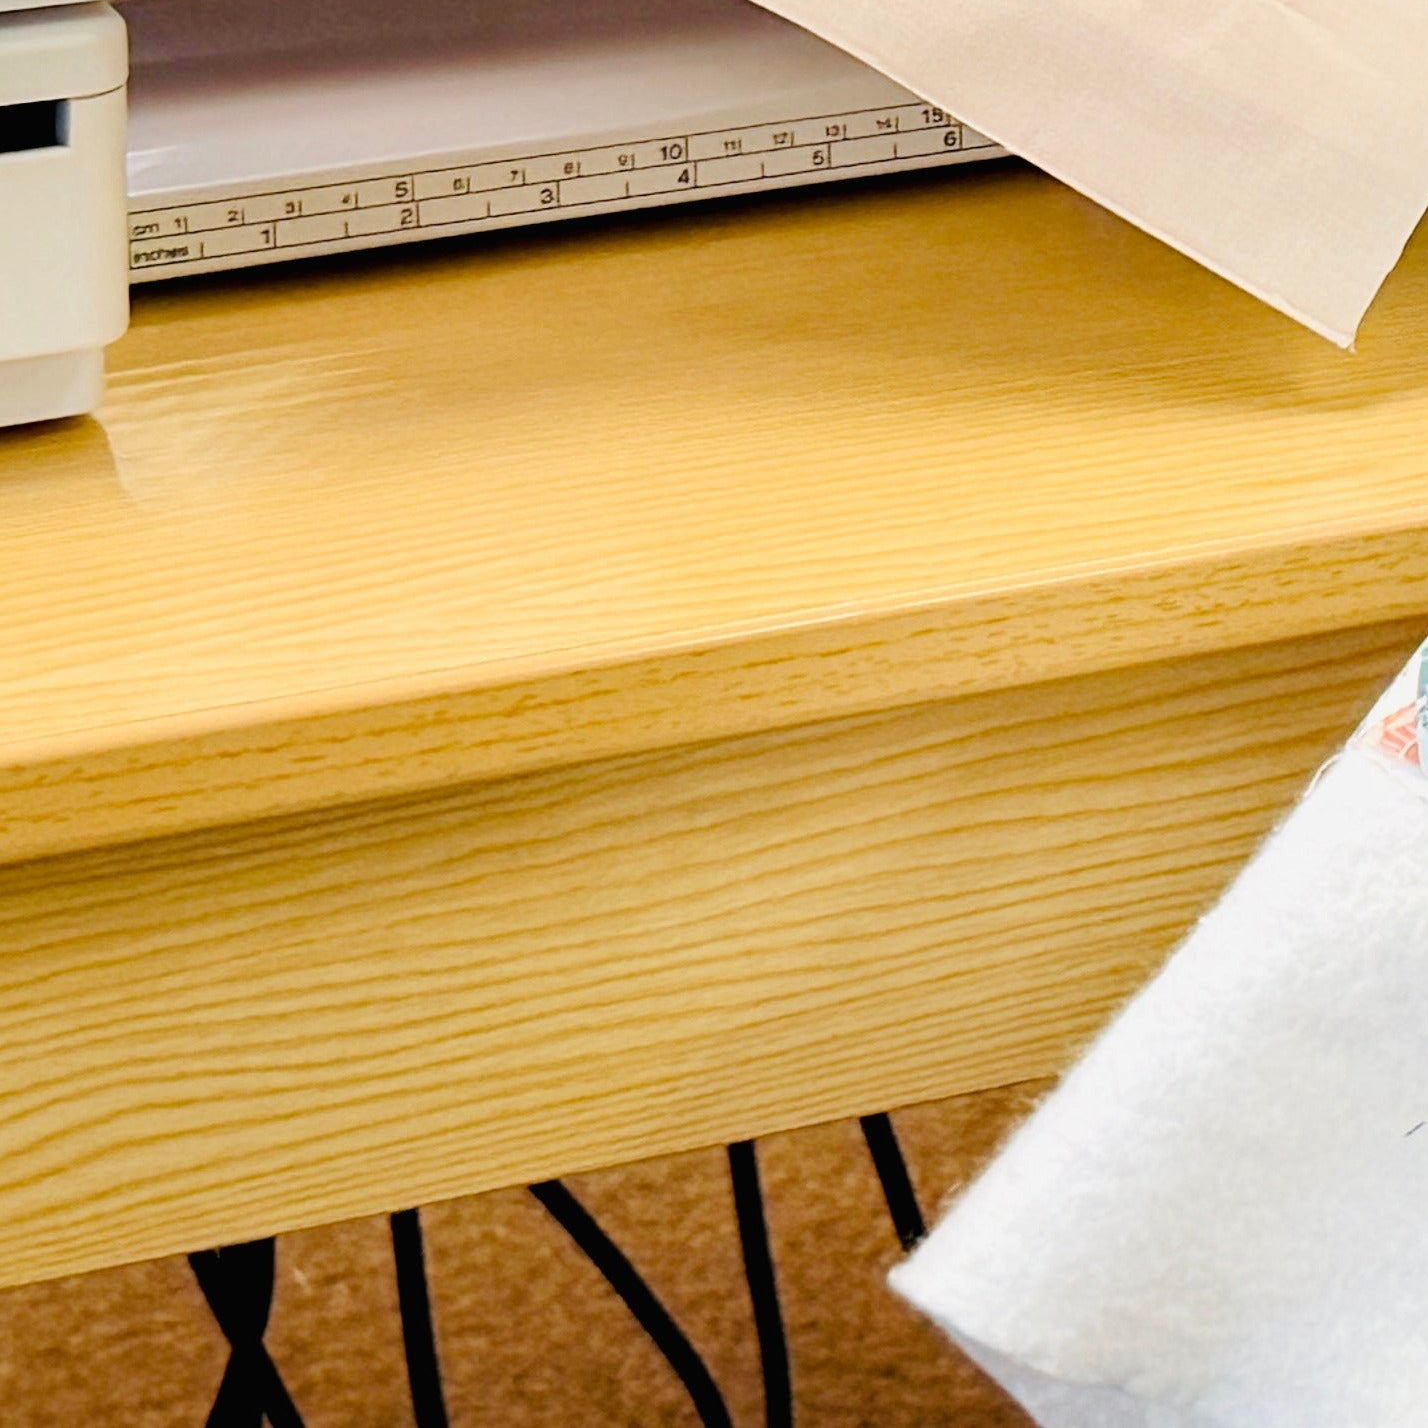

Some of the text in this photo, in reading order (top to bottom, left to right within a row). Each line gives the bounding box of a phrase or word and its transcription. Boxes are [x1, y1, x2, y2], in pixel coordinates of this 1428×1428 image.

[395, 180, 409, 198] 5
[660, 143, 683, 162] 10
[401, 207, 413, 226] 2
[540, 187, 554, 206] 3
[677, 167, 689, 185] 4
[812, 149, 825, 167] 5
[943, 130, 957, 148] 6
